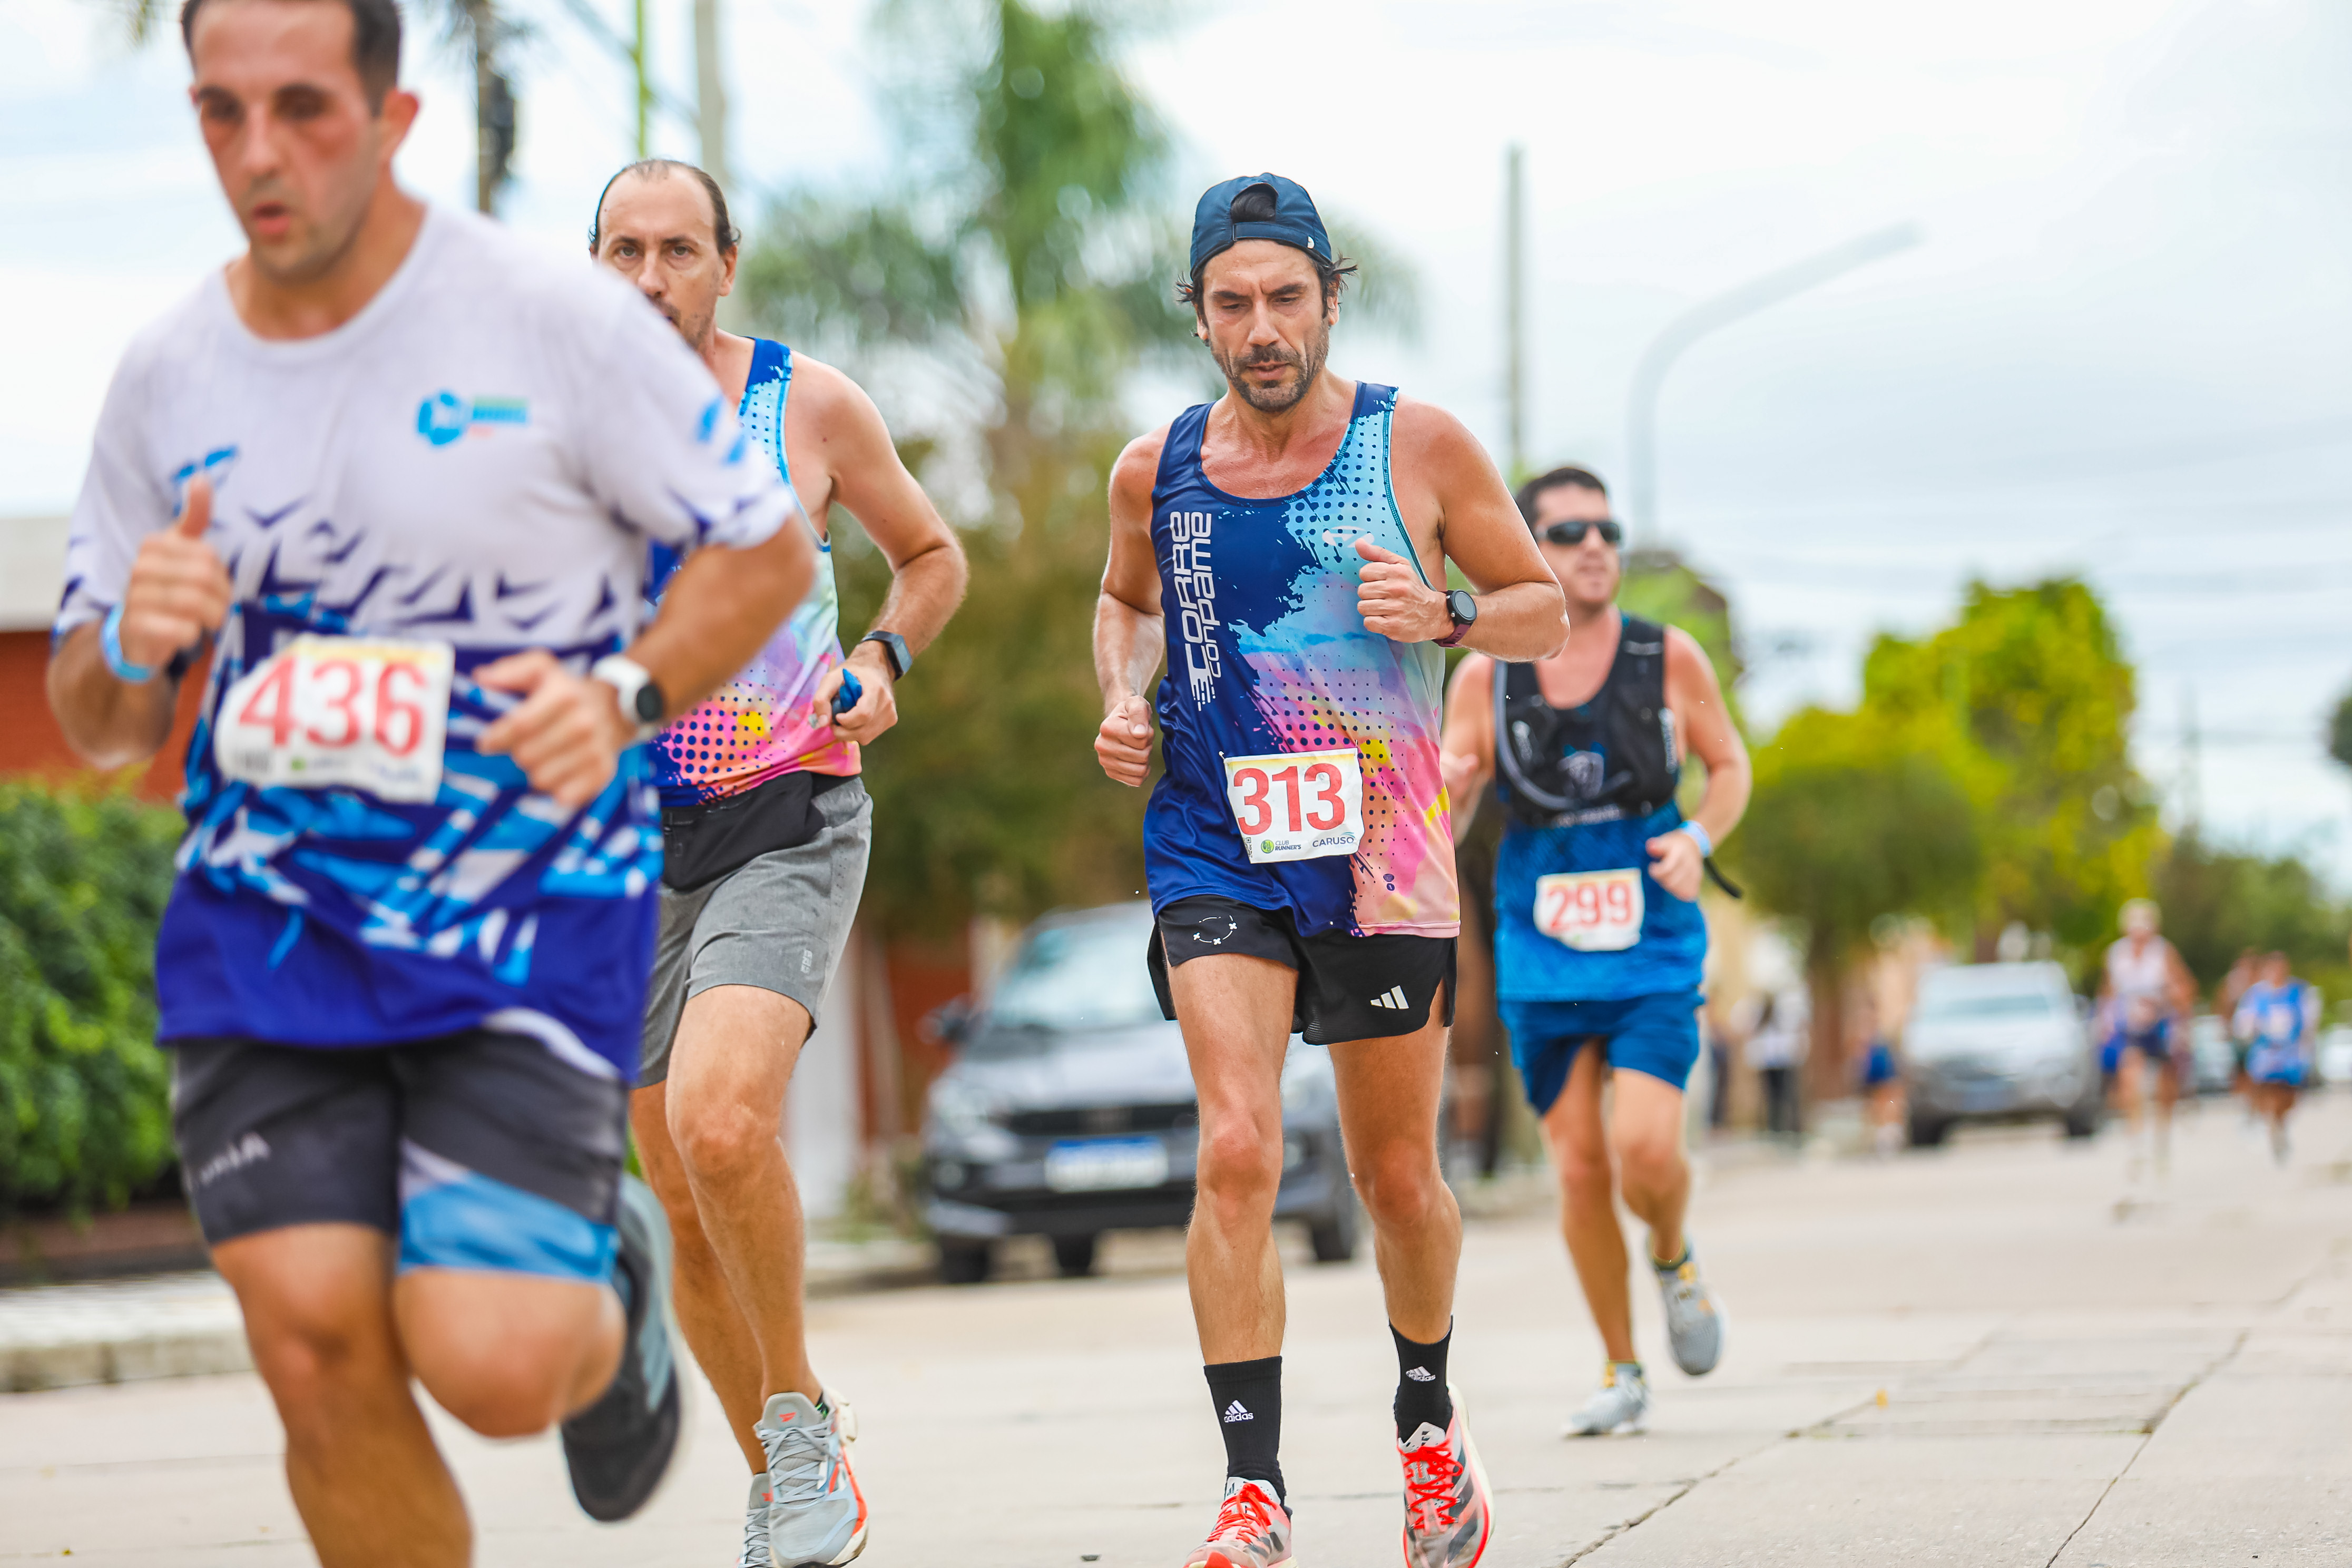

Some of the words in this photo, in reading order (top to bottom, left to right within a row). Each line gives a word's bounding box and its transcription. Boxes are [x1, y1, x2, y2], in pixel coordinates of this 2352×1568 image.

[239, 655, 429, 758] 436
[1233, 763, 1345, 835] 313
[1312, 837, 1354, 847] CARUSO
[1547, 879, 1632, 933] 299
[1224, 1413, 1253, 1423] adidas
